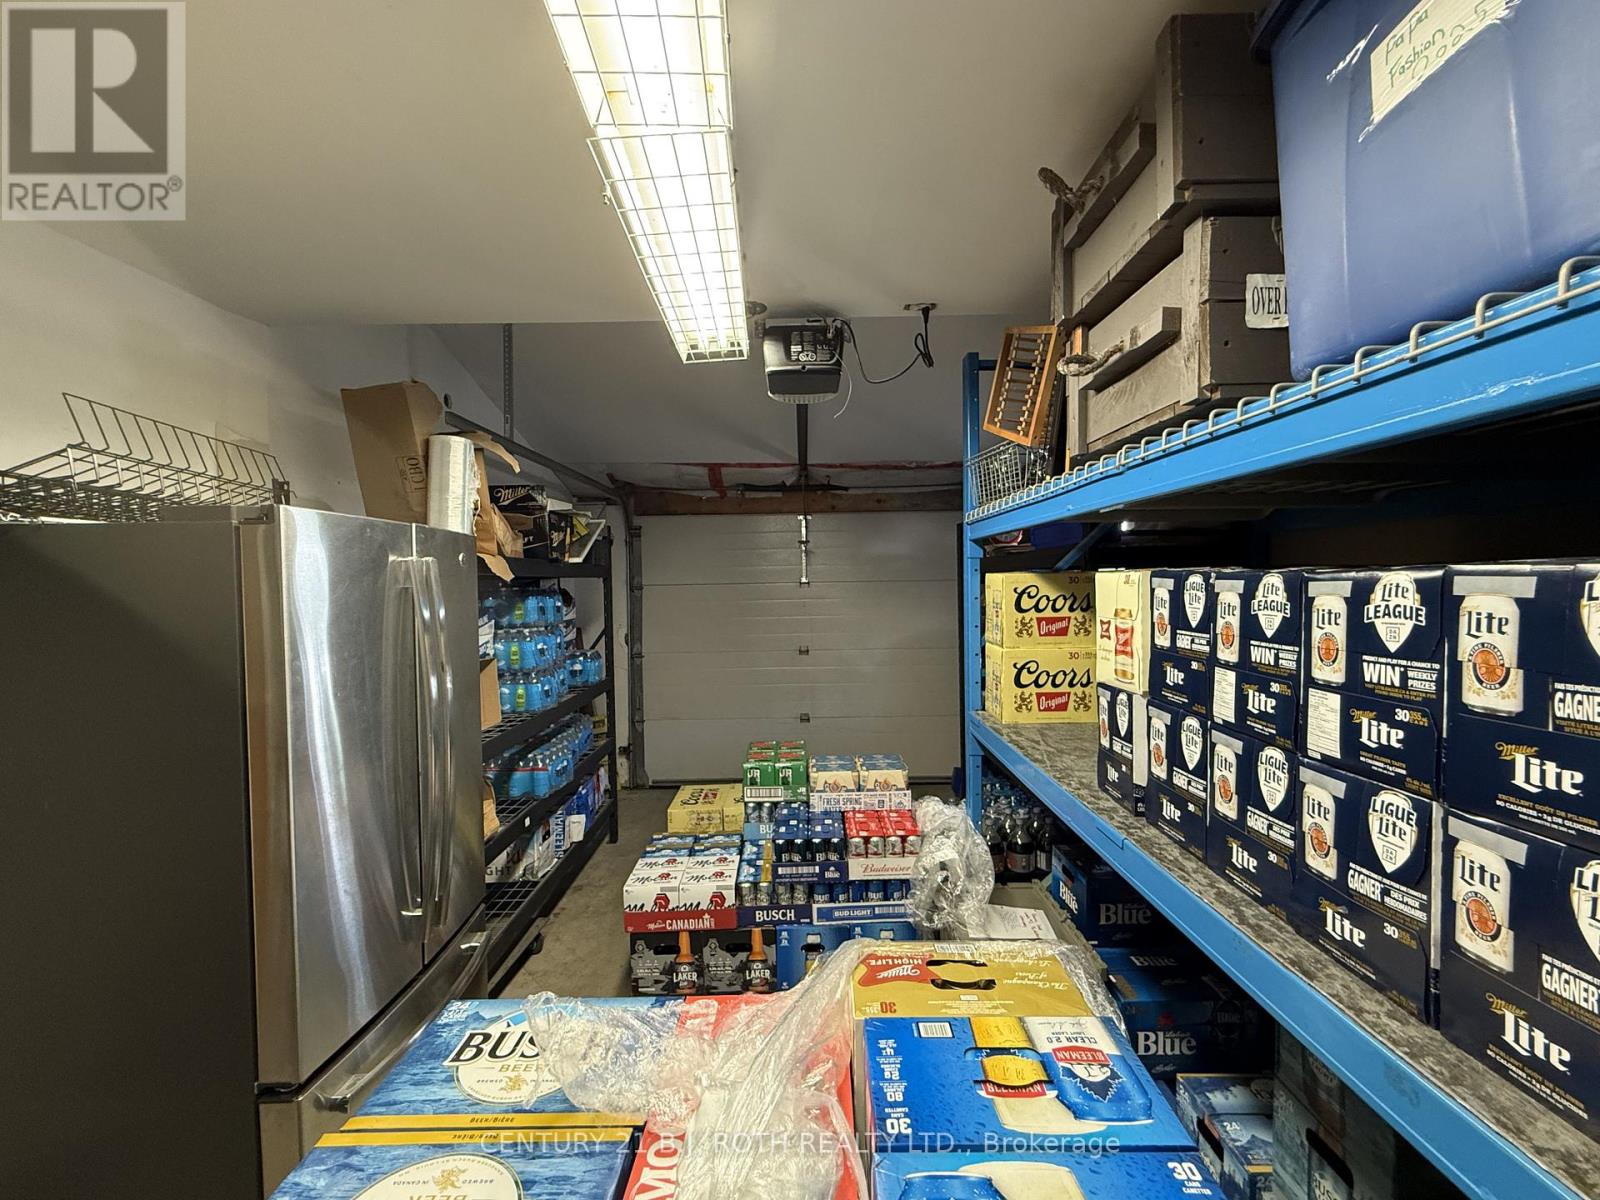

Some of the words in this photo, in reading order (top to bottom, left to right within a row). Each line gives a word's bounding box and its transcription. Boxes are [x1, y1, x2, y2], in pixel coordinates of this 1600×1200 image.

[1387, 28, 1446, 88] Fashion
[1251, 286, 1281, 315] OVER
[493, 486, 530, 506] Miller
[1068, 576, 1080, 585] 30
[1185, 581, 1205, 593] LIGUE
[1013, 584, 1094, 613] Coors
[1262, 582, 1280, 599] Lite
[1380, 582, 1410, 602] Lite
[1220, 601, 1237, 620] Lite
[1251, 599, 1290, 616] LEAGUE
[1365, 603, 1425, 625] LEAGUE
[1040, 618, 1069, 636] Original
[1315, 607, 1342, 630] Lite
[1464, 609, 1510, 639] Lite
[1068, 652, 1080, 660] 30
[1013, 660, 1094, 689] Coors
[1165, 665, 1185, 686] Lite
[1407, 670, 1438, 681] WEEKLY
[1269, 681, 1280, 693] 30
[1407, 679, 1437, 690] PRIZES
[1039, 693, 1069, 710] Original
[1246, 688, 1277, 714] Lite
[1554, 691, 1600, 723] GAGNE
[1394, 708, 1410, 722] 30
[1151, 725, 1164, 742] Lite
[1182, 722, 1202, 736] LIGUE
[1359, 716, 1405, 749] Lite
[1185, 734, 1199, 749] Lite
[1495, 741, 1539, 761] Miller
[1216, 752, 1234, 774] Lite
[1259, 753, 1287, 776] LIGUE
[1263, 767, 1283, 787] Lite
[1510, 752, 1584, 796] Lite
[1161, 798, 1182, 823] Lite
[1306, 795, 1331, 822] Lite
[1371, 798, 1416, 828] LIGUE
[1505, 803, 1538, 817] CALORIES
[1376, 816, 1407, 842] Lite
[1231, 842, 1258, 874] Lite
[1267, 850, 1277, 863] 30
[486, 865, 512, 876] GHT
[824, 871, 841, 879] Blue
[860, 863, 912, 874] Budweiser
[1458, 854, 1501, 893] Lite
[1059, 880, 1079, 914] Blue
[755, 909, 796, 922] BUSCH
[851, 909, 872, 917] LIGHT
[1099, 902, 1153, 926] Blue
[666, 917, 712, 931] CANADIAN
[1325, 906, 1367, 949] Lite
[1383, 922, 1399, 939] 30
[868, 958, 892, 966] LIFE
[893, 958, 923, 966] HIGH
[1129, 955, 1180, 967] Blue
[673, 971, 698, 982] LAKER
[745, 969, 770, 981] LAKER
[875, 965, 921, 979] Miller
[1002, 976, 1050, 989] Champagne
[1541, 962, 1600, 1015] GAGNER
[879, 1001, 897, 1014] 30
[1485, 992, 1528, 1018] Miller
[448, 1030, 541, 1063] BUS
[1045, 1036, 1062, 1044] 2.0
[1065, 1035, 1098, 1045] CLEAR
[1136, 1030, 1198, 1056] Blue
[1500, 1007, 1571, 1072] Lite
[885, 1117, 913, 1135] 30
[1223, 1121, 1240, 1131] 24
[1166, 1161, 1203, 1181] 30
